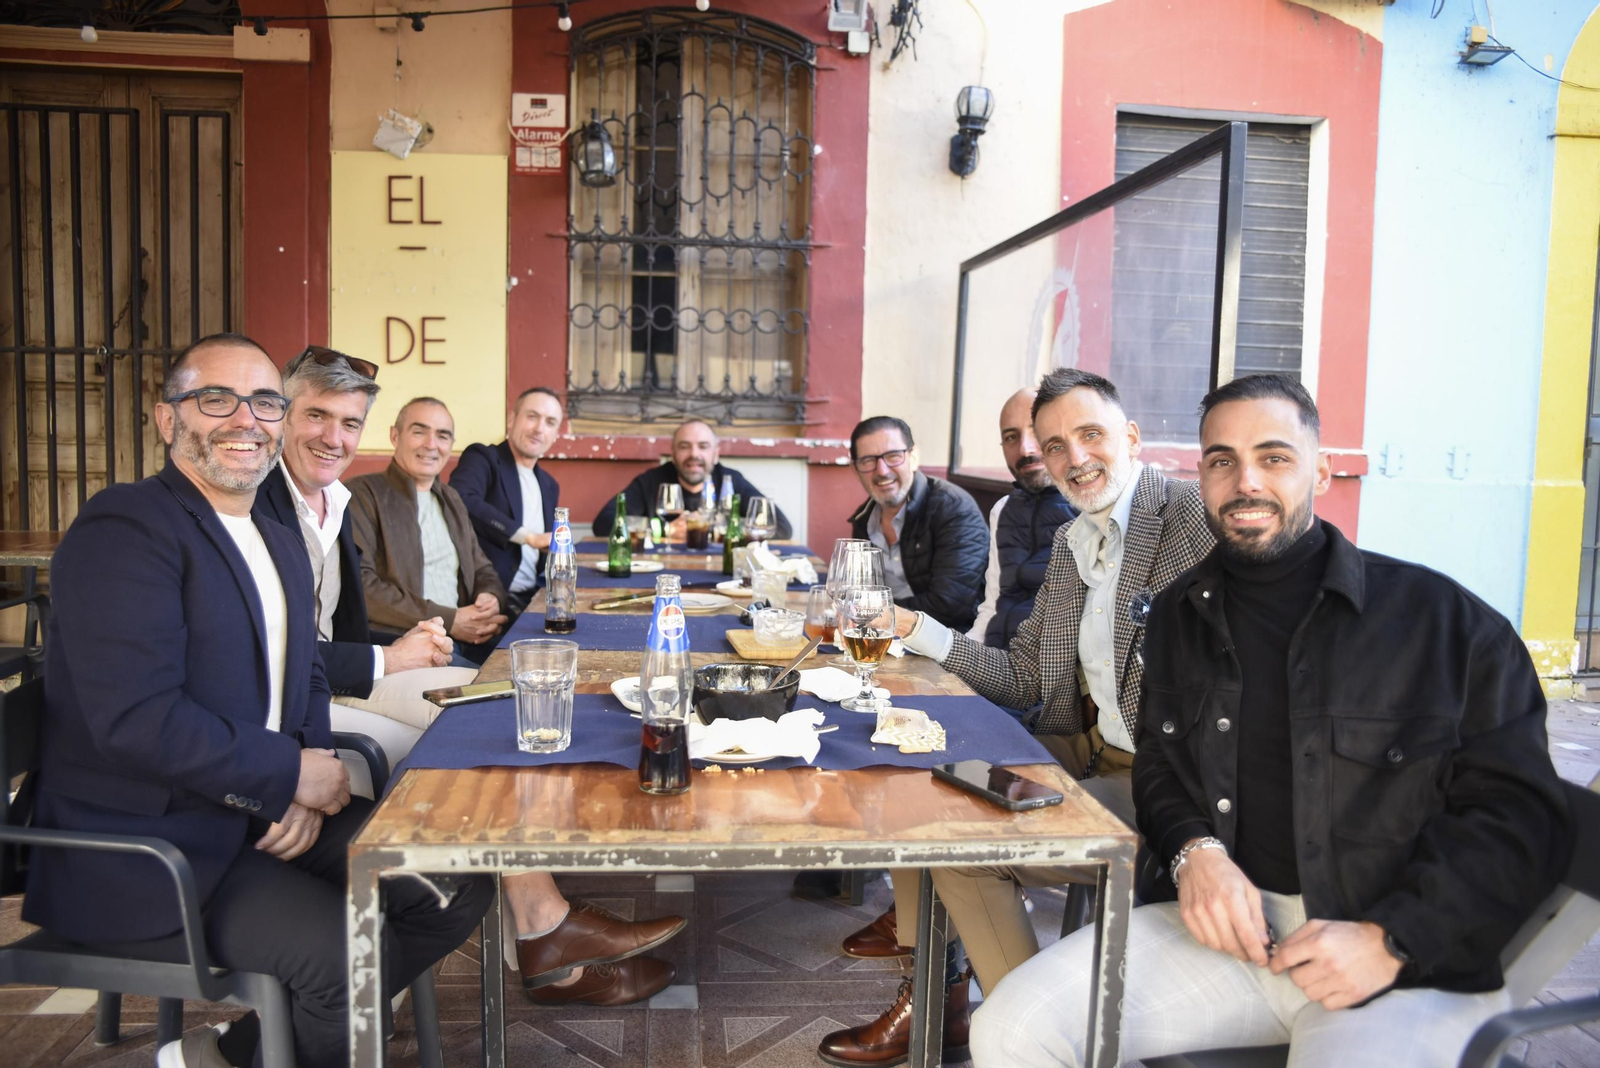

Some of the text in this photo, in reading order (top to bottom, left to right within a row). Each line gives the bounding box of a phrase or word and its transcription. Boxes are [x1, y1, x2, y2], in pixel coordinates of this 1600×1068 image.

[516, 128, 561, 141] Alarma
[388, 175, 442, 225] EL
[386, 316, 446, 364] DE
[660, 618, 684, 626] PEPS
